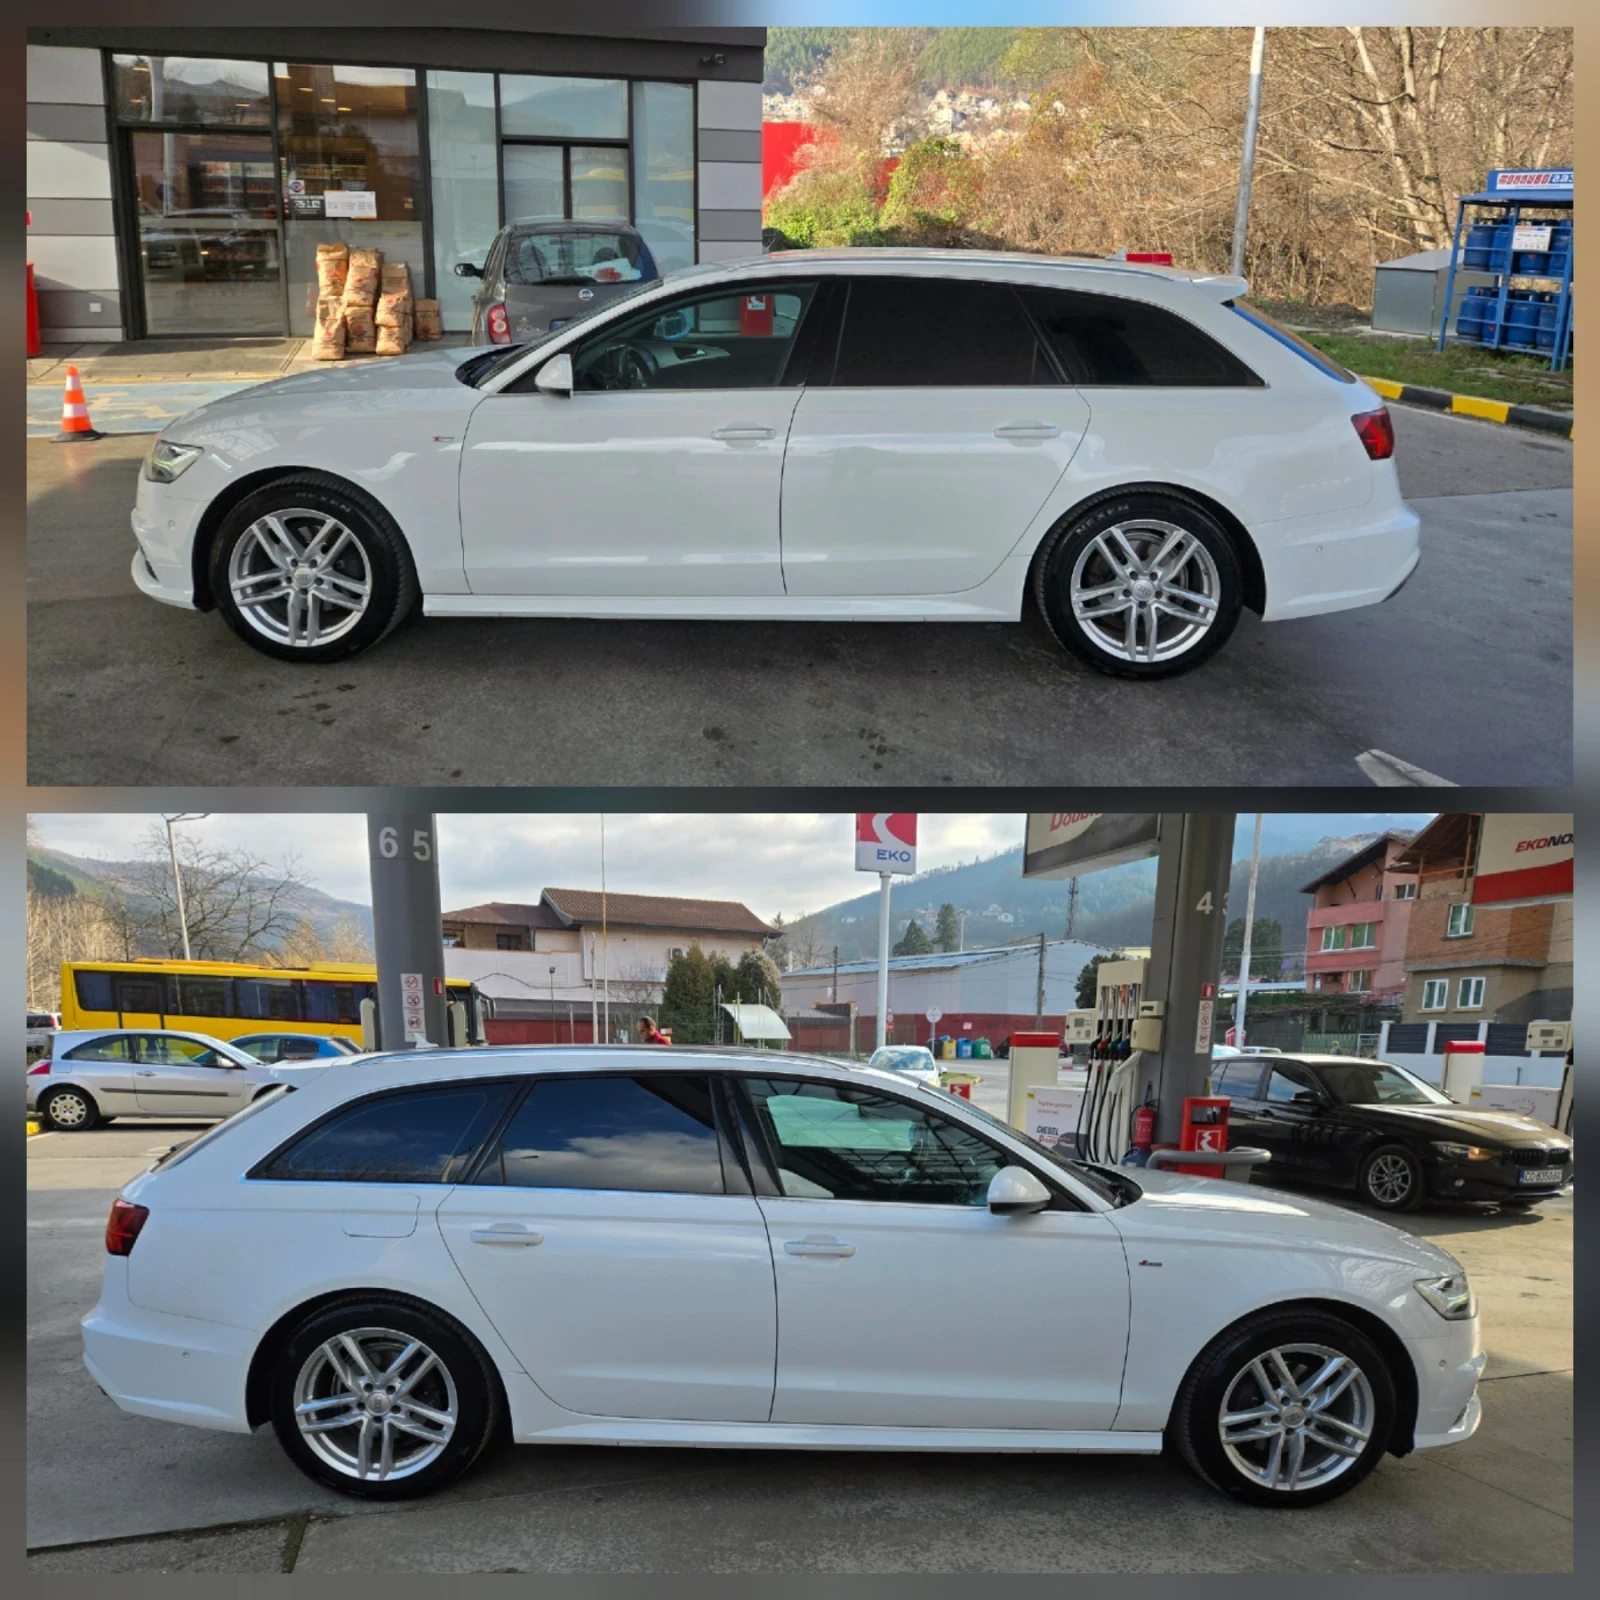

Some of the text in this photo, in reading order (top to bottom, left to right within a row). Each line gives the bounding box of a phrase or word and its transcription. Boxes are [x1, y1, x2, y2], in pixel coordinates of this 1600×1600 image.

[1050, 812, 1100, 832] Dou
[379, 826, 431, 861] 6 5
[1515, 833, 1574, 853] EKONO
[876, 848, 911, 863] EKO
[1195, 890, 1214, 915] 4
[1036, 1125, 1059, 1136] DIESEL
